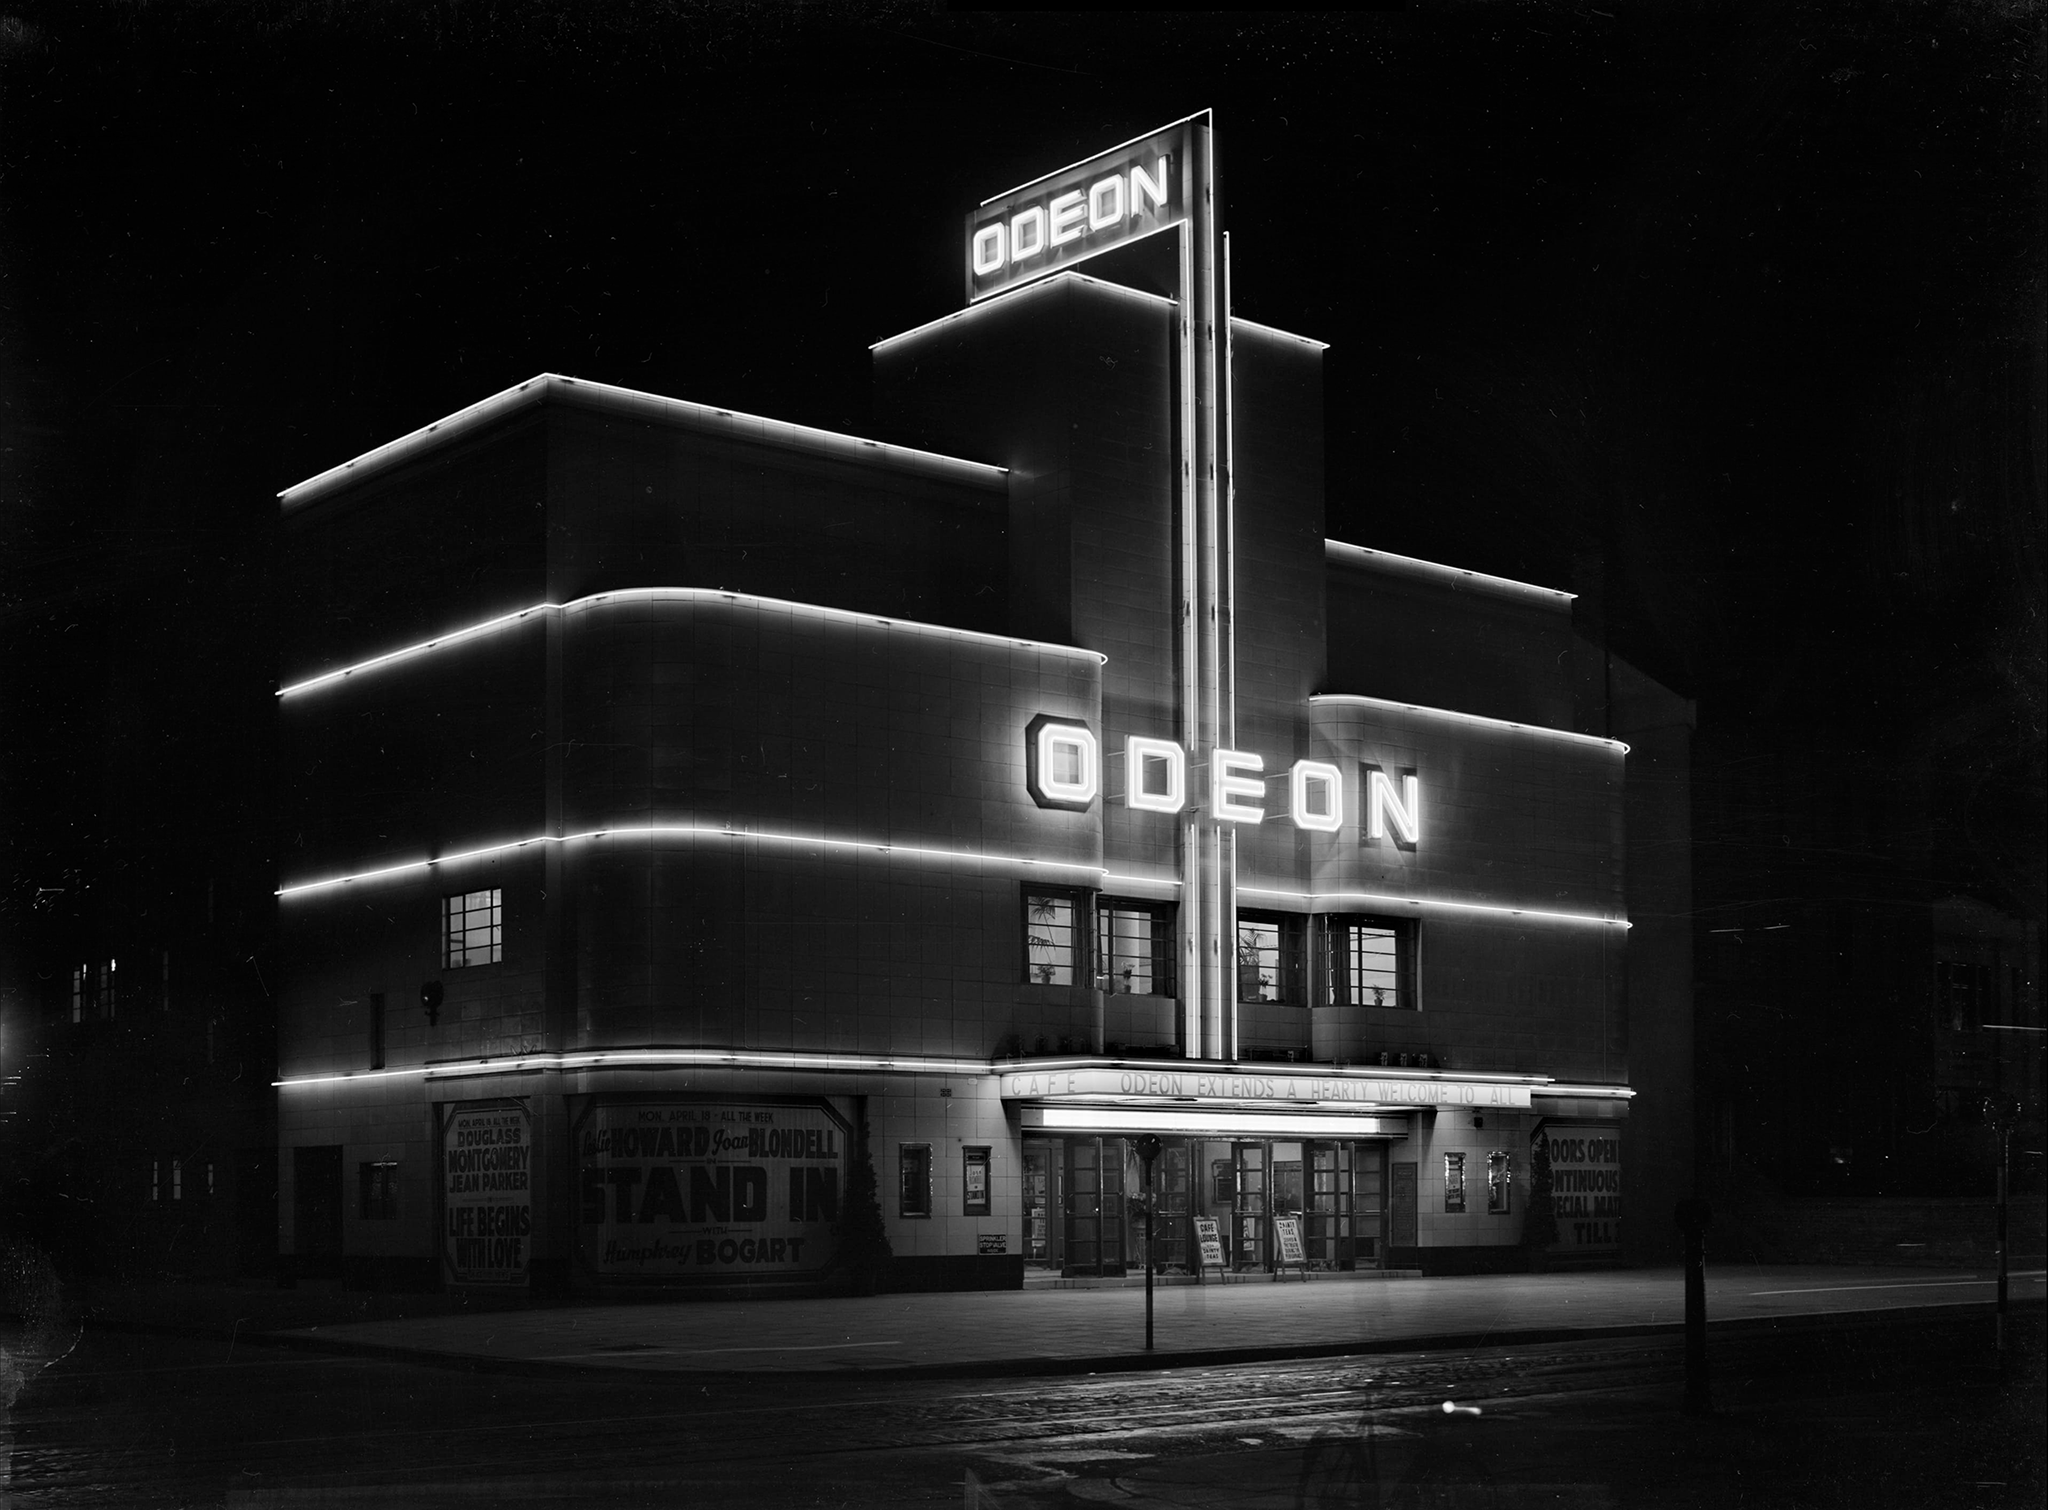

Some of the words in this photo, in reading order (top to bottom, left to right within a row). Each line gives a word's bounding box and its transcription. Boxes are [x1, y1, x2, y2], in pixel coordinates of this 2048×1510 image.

[973, 154, 1169, 276] ODEON
[1037, 722, 1420, 843] ODEON
[1011, 1073, 1076, 1096] CAFE
[1120, 1073, 1183, 1095] ODEON
[1199, 1075, 1274, 1098] EXTENDS
[1286, 1078, 1297, 1099] A
[1311, 1080, 1368, 1100] HEARTY
[1377, 1082, 1447, 1102] WELCOME
[1458, 1085, 1475, 1104] TO
[1491, 1086, 1515, 1105] ALL
[669, 1111, 697, 1122] APRIL
[701, 1110, 711, 1121] 18
[721, 1111, 736, 1121] ALL
[739, 1112, 752, 1121] THE
[754, 1112, 774, 1123] WEEK
[458, 1127, 522, 1147] DOUGLASS
[611, 1127, 710, 1158] HOWARD
[711, 1129, 749, 1156] Joan
[748, 1127, 838, 1159] BLONDELL
[1549, 1138, 1586, 1164] OORS
[449, 1146, 529, 1173] MONTGOMERY
[449, 1173, 479, 1193] JEAN
[482, 1171, 528, 1192] PARKER
[582, 1166, 768, 1224] STAND
[789, 1166, 838, 1222] IN
[1551, 1195, 1590, 1218] PECIAL
[449, 1206, 475, 1237] LIFE
[477, 1205, 531, 1237] BEGINS
[1573, 1222, 1612, 1245] TILL
[457, 1237, 486, 1269] WITH
[487, 1237, 522, 1269] LOVE
[603, 1238, 692, 1266] Humphrey
[695, 1237, 805, 1266] BOGART
